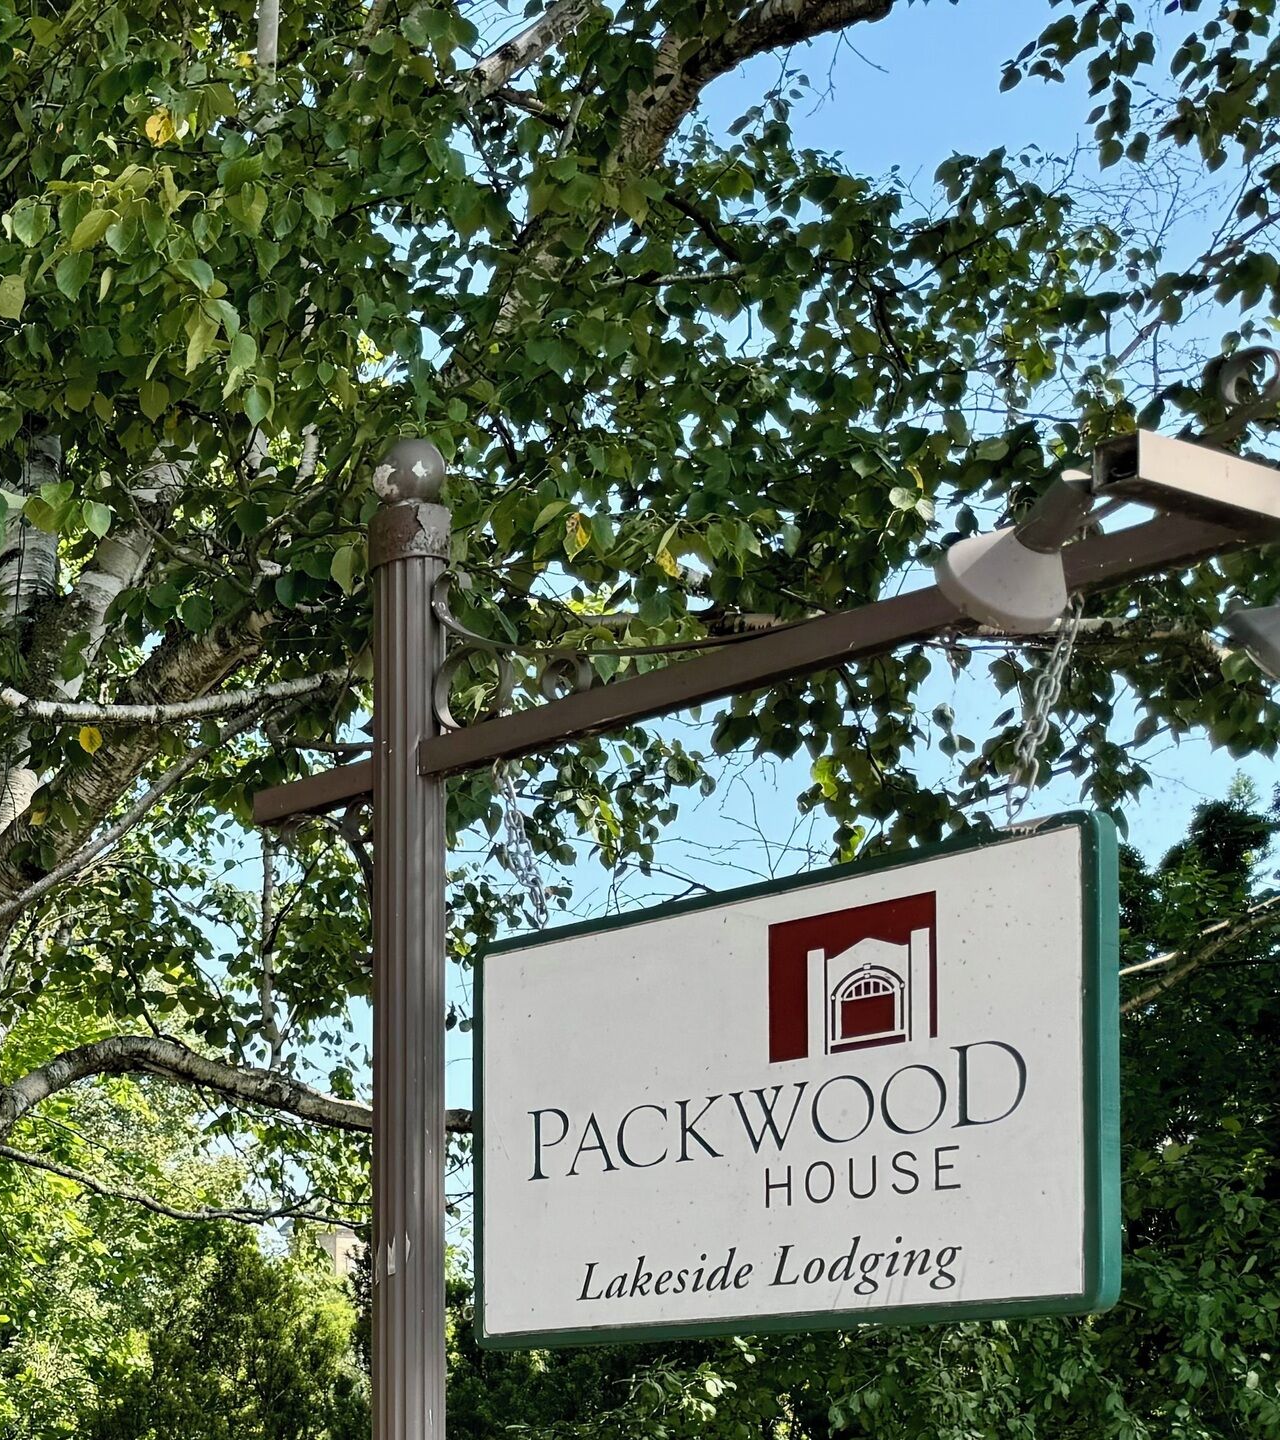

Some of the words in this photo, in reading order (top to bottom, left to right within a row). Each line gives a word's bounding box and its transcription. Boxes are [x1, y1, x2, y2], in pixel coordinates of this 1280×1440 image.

[528, 1041, 1027, 1180] PACKWOOD
[765, 1145, 962, 1208] HOUSE
[577, 1248, 753, 1302] Lakeside
[768, 1236, 963, 1295] Lodging
